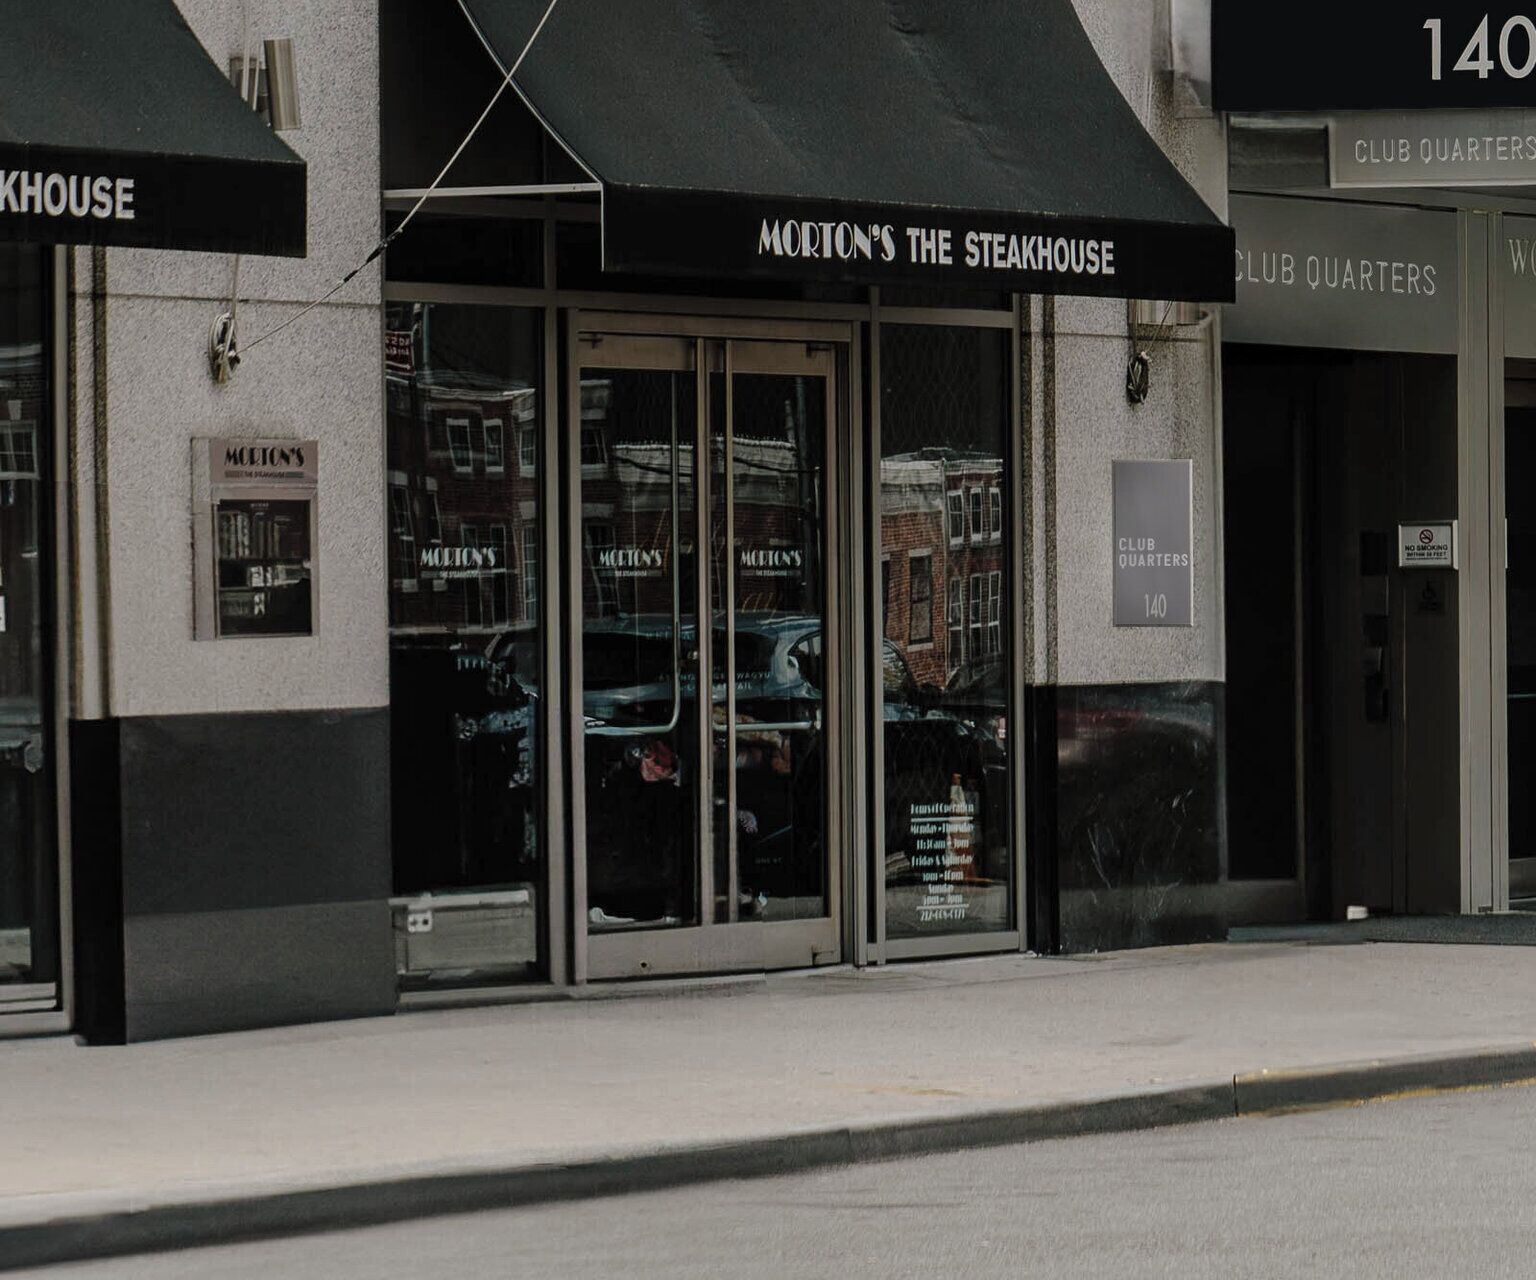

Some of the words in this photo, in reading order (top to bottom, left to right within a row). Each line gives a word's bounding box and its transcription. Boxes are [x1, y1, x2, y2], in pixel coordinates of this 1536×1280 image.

[1354, 138, 1411, 164] CLUB
[0, 169, 136, 220] KHOUSE
[758, 218, 896, 262] MORTON'S
[906, 227, 953, 266] THE
[965, 230, 1116, 275] STEAKHOUSE
[1306, 255, 1437, 296] QUARTERS
[224, 446, 304, 466] MORTON'S
[1118, 537, 1156, 551] CLUB
[420, 547, 497, 567] MORTON'S
[598, 548, 663, 567] MORTON'S
[739, 549, 803, 567] MORTON'S
[1118, 553, 1189, 569] QUARTERS
[1144, 593, 1167, 618] 140
